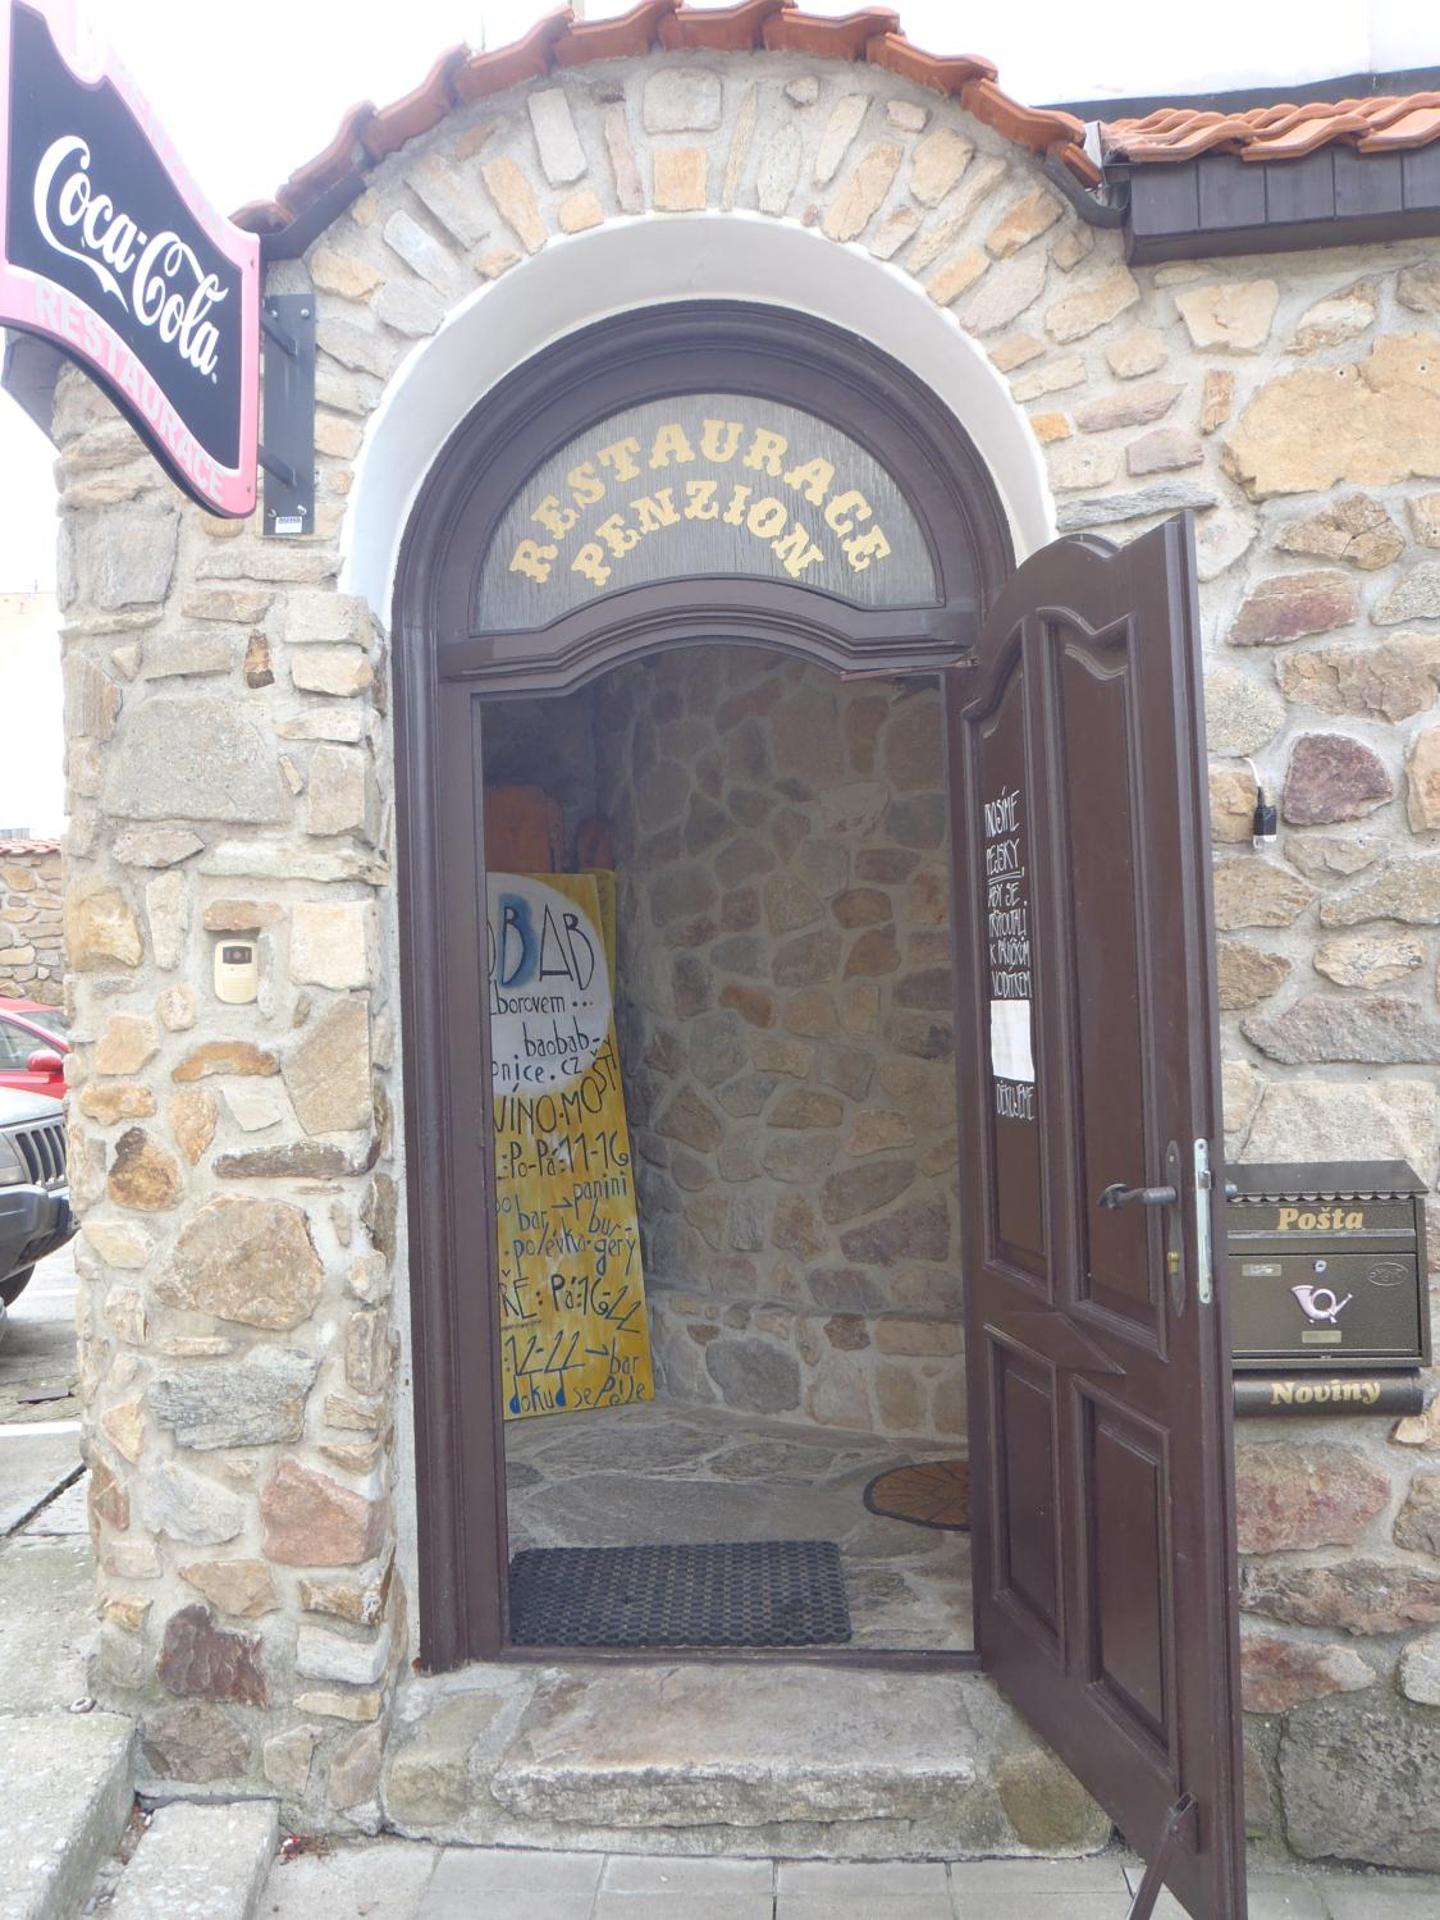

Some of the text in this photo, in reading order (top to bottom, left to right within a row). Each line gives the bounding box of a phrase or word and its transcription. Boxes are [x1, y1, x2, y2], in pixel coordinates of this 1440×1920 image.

[33, 135, 229, 384] Coca-Cola
[33, 285, 224, 503] RESTAURACE
[509, 419, 892, 585] RESTAURACE
[570, 480, 825, 587] PENZION
[515, 1193, 547, 1231] bar
[572, 1169, 627, 1221] panini
[1277, 1206, 1364, 1231] Pošta
[610, 1336, 640, 1375] bar
[509, 1368, 567, 1414] dokud
[1270, 1379, 1381, 1405] Noviny
